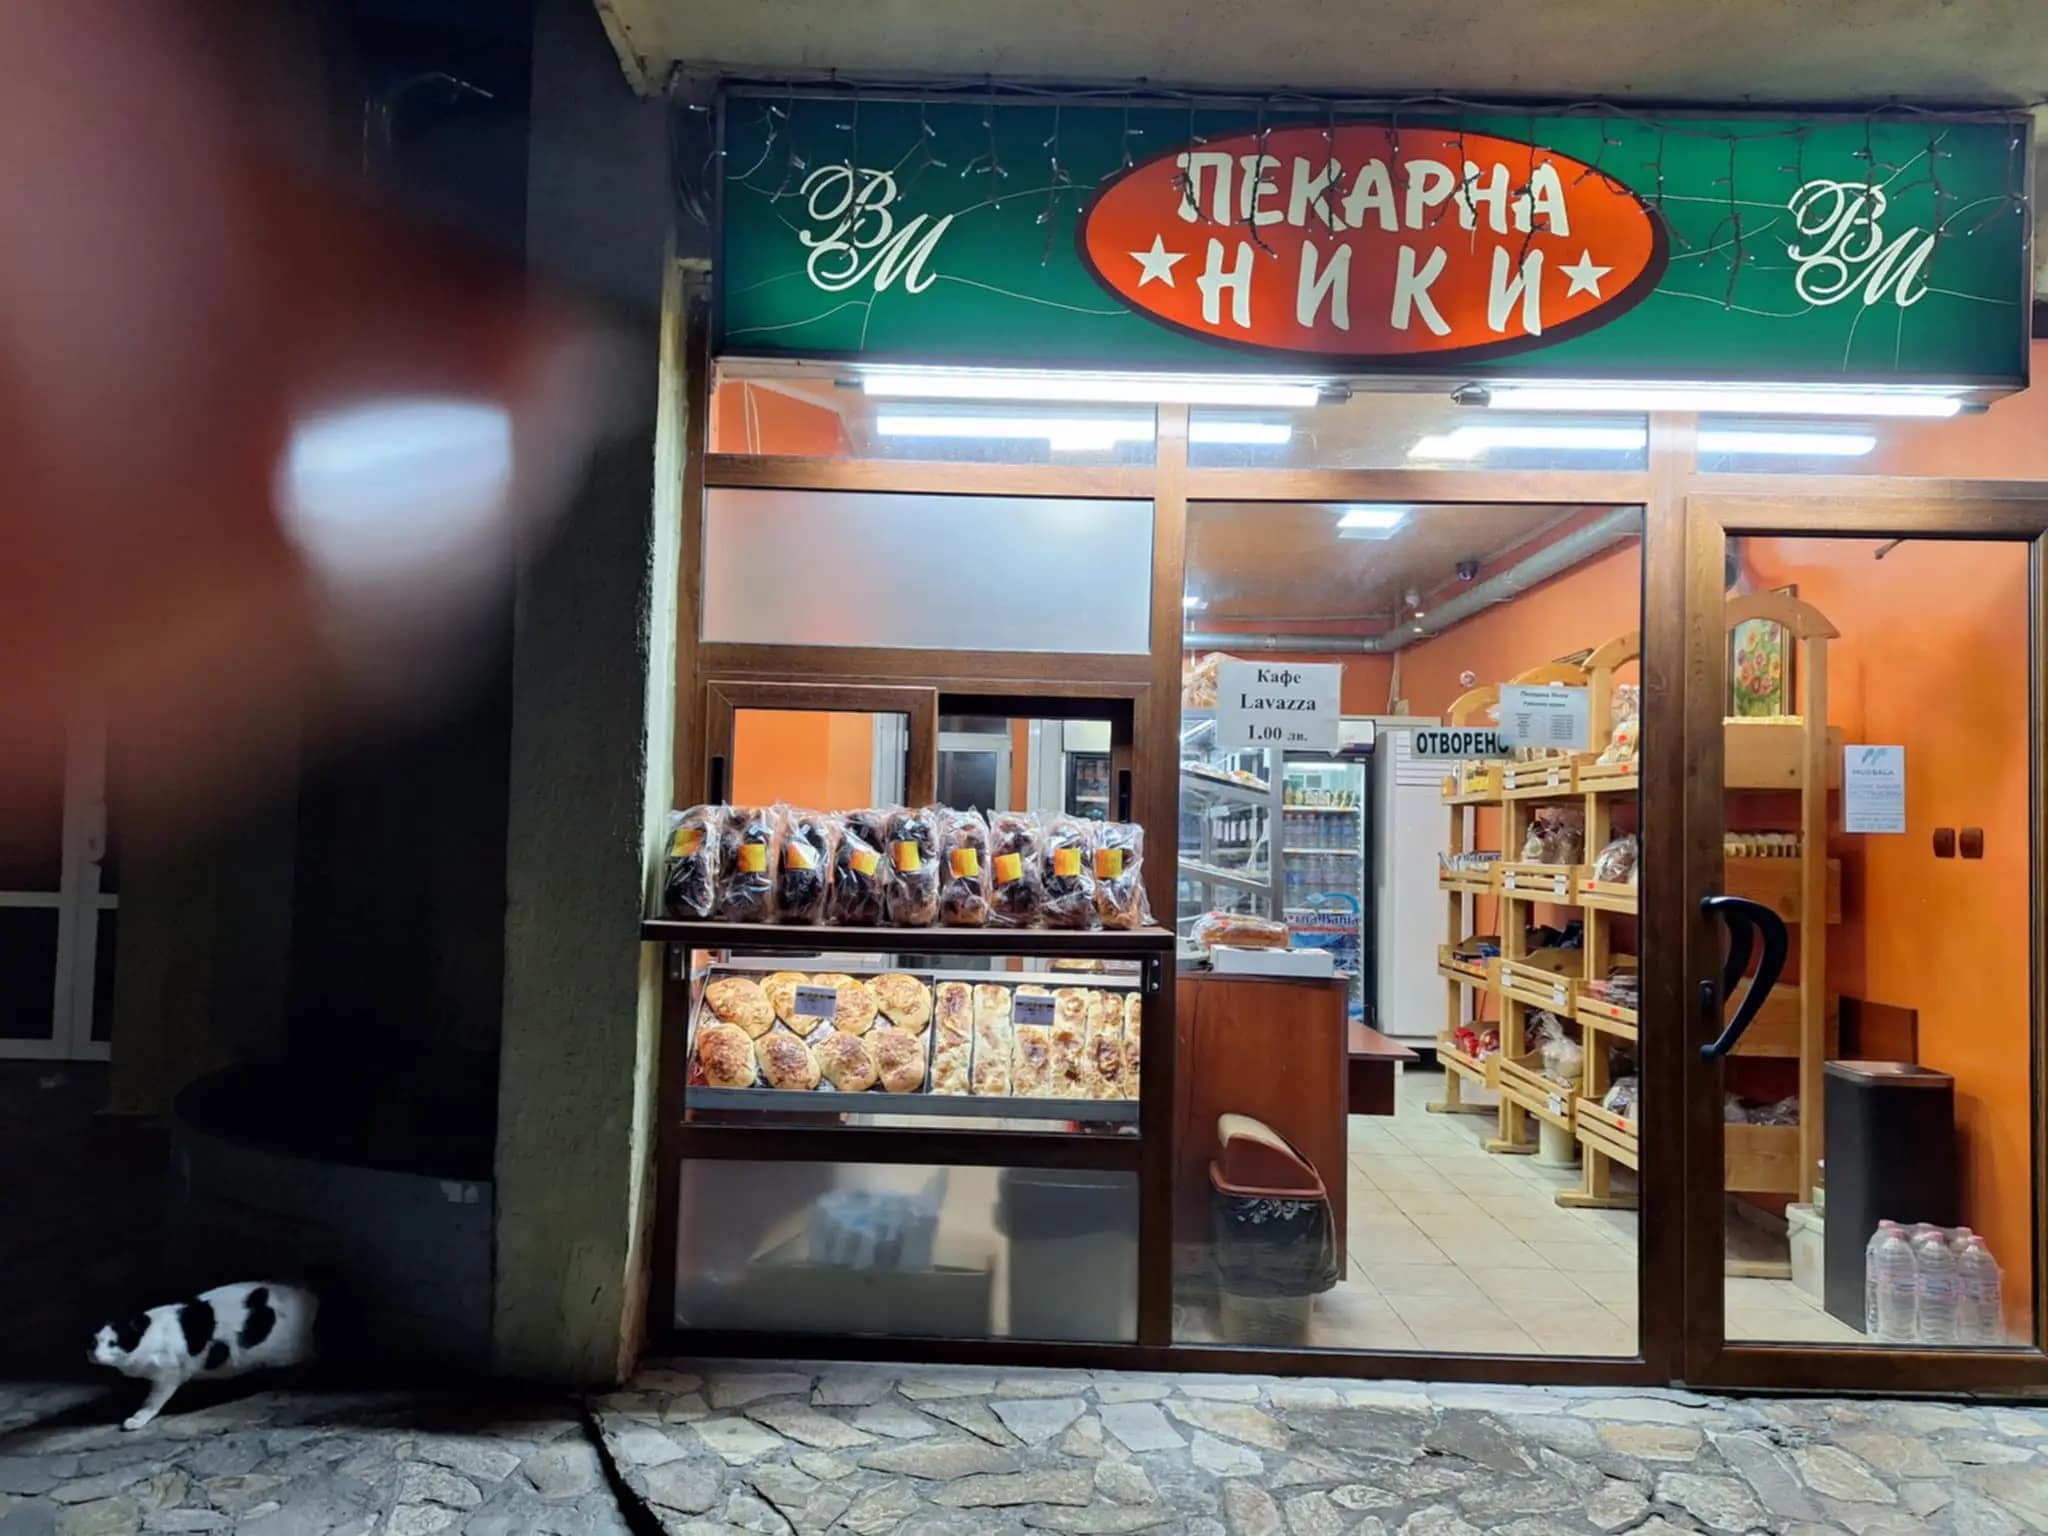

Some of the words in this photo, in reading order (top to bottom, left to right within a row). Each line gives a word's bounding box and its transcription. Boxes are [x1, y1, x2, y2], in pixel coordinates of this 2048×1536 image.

[1176, 152, 1570, 237] ПЕКАРНА
[1196, 237, 1543, 337] НИКИ
[1257, 668, 1302, 688] Кафе
[1240, 693, 1316, 711] Lavazza
[1249, 724, 1283, 740] 1.00
